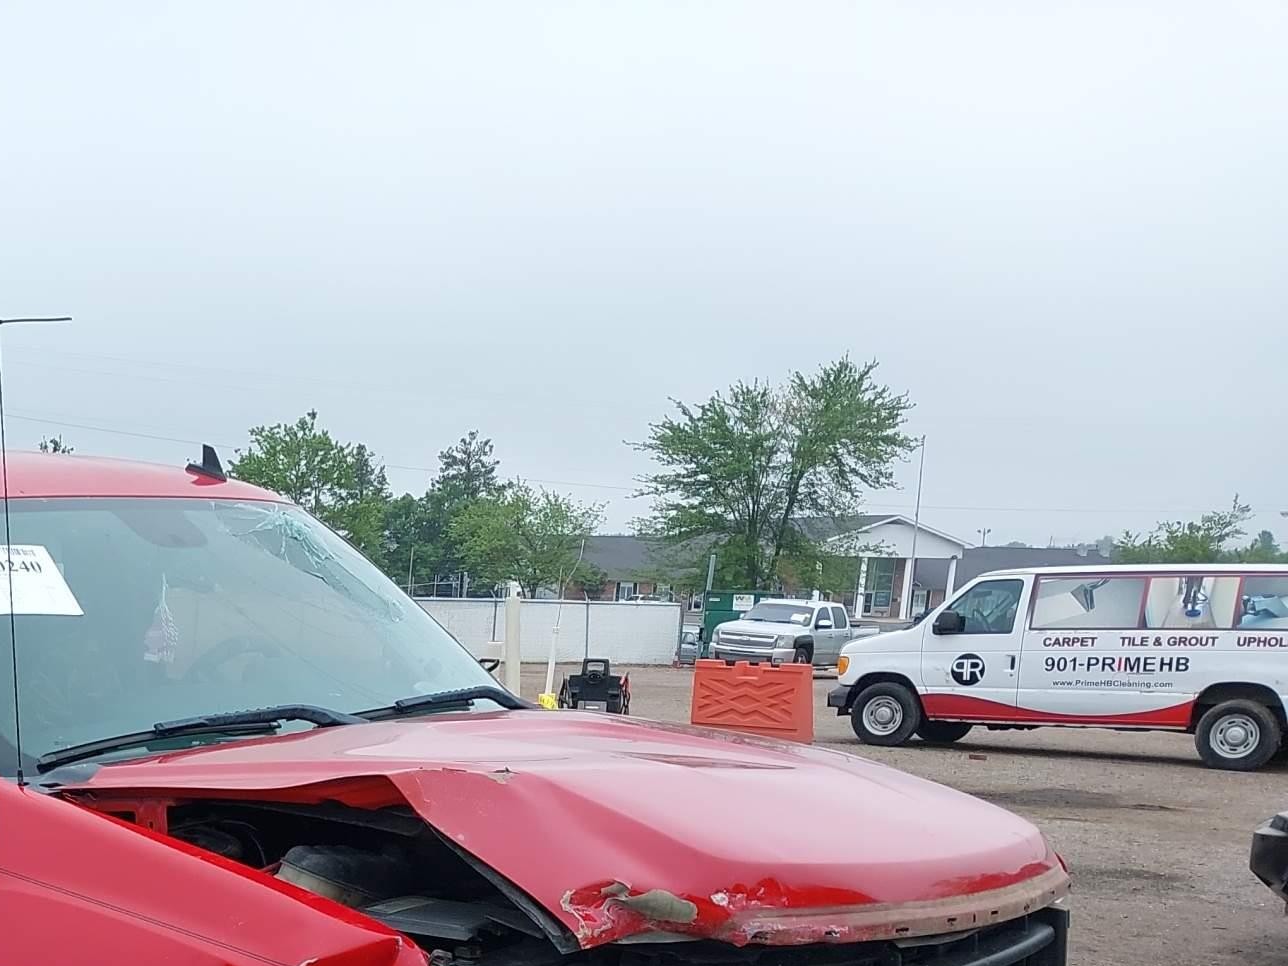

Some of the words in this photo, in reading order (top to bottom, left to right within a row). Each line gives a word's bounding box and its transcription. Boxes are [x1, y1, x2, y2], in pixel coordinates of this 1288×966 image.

[1043, 636, 1098, 648] CARPET
[1119, 636, 1150, 647] TILE
[1152, 636, 1163, 647] &
[1167, 636, 1219, 648] GROUT
[1236, 636, 1288, 648] UPHOL
[1052, 679, 1173, 689] www.PrimeHBCleaning.com
